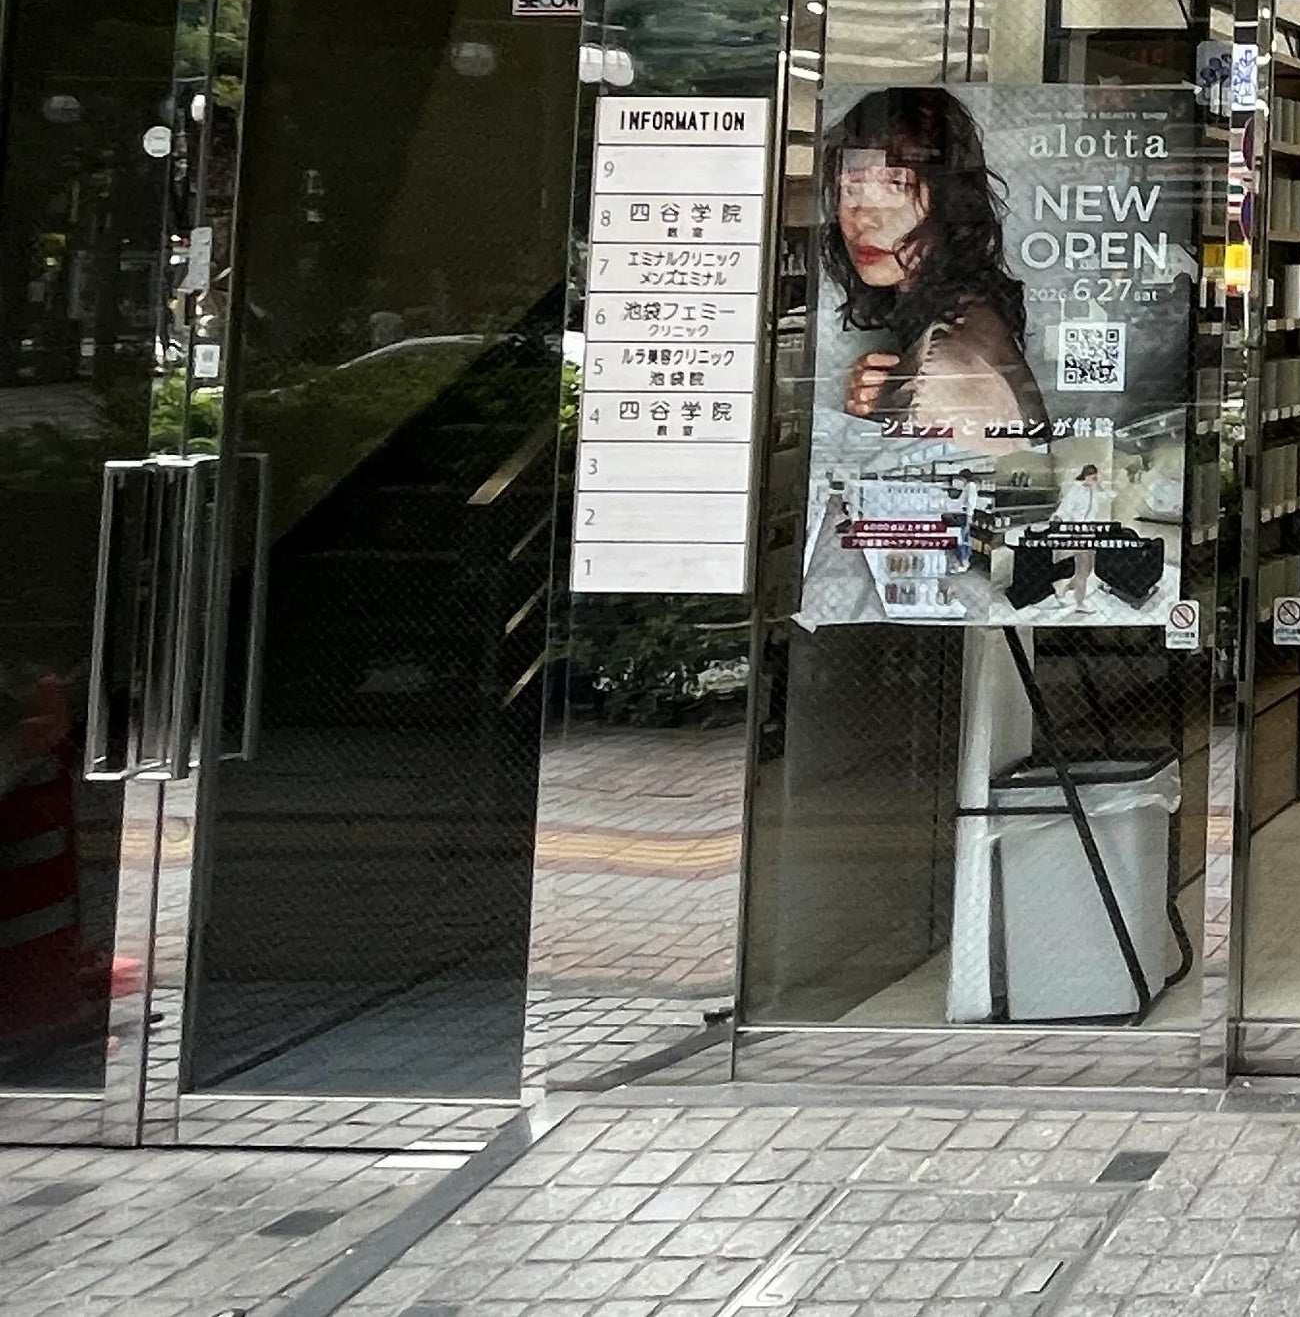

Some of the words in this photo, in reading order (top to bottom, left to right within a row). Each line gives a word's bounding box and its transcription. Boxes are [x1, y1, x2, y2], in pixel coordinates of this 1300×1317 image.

[619, 109, 746, 132] INFORMATION
[1028, 122, 1169, 159] alotta
[603, 160, 615, 179] 9
[600, 209, 612, 228] 8
[629, 202, 742, 224] 四谷学院
[1034, 184, 1162, 223] NEW
[1020, 231, 1169, 271] OPEN
[599, 258, 610, 276] 7
[627, 250, 741, 267] エミナルクリニック
[639, 268, 727, 287] メンズエミナル
[595, 308, 607, 326] 6
[622, 301, 736, 322] 池袋フェミー
[647, 323, 710, 338] クリニック
[593, 357, 604, 376] 5
[588, 408, 600, 425] 4
[619, 400, 733, 422] 四谷学院
[588, 457, 599, 476] 3
[584, 507, 596, 526] 2
[584, 558, 593, 576] 1
